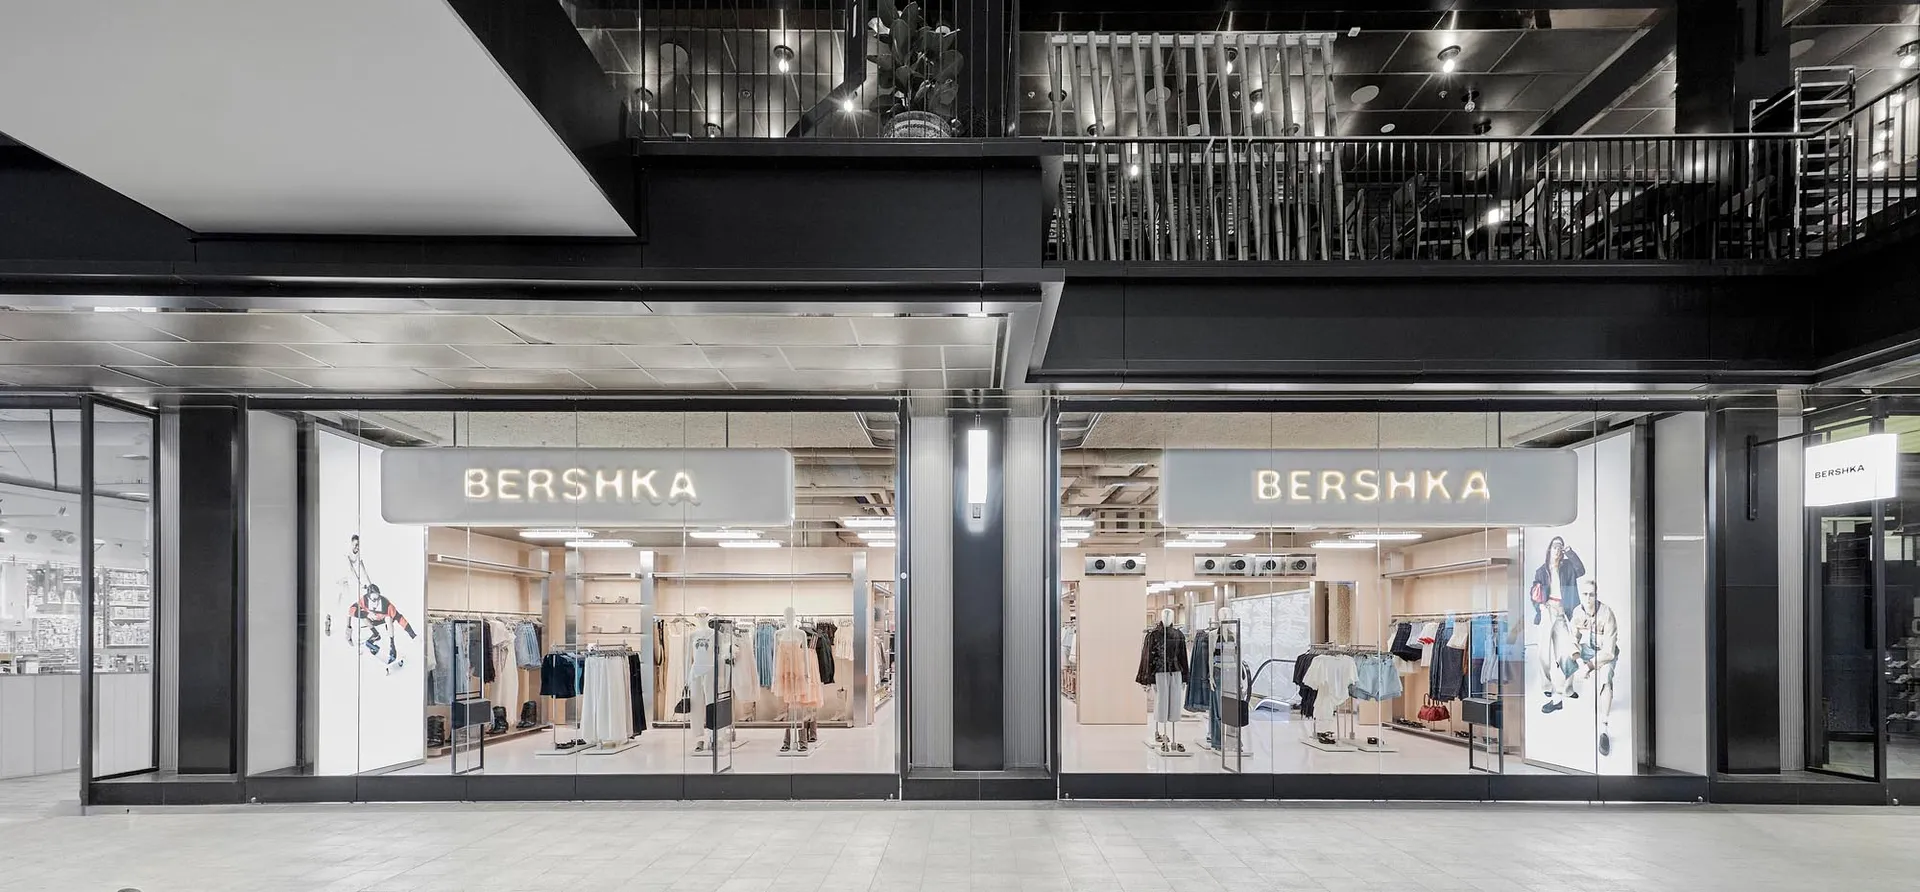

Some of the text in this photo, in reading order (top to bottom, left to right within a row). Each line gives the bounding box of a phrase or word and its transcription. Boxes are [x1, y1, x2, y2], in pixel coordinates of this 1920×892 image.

[464, 467, 698, 501] BERSHKA
[1256, 468, 1490, 502] BERSHKA
[1814, 464, 1865, 479] BERSHKA
